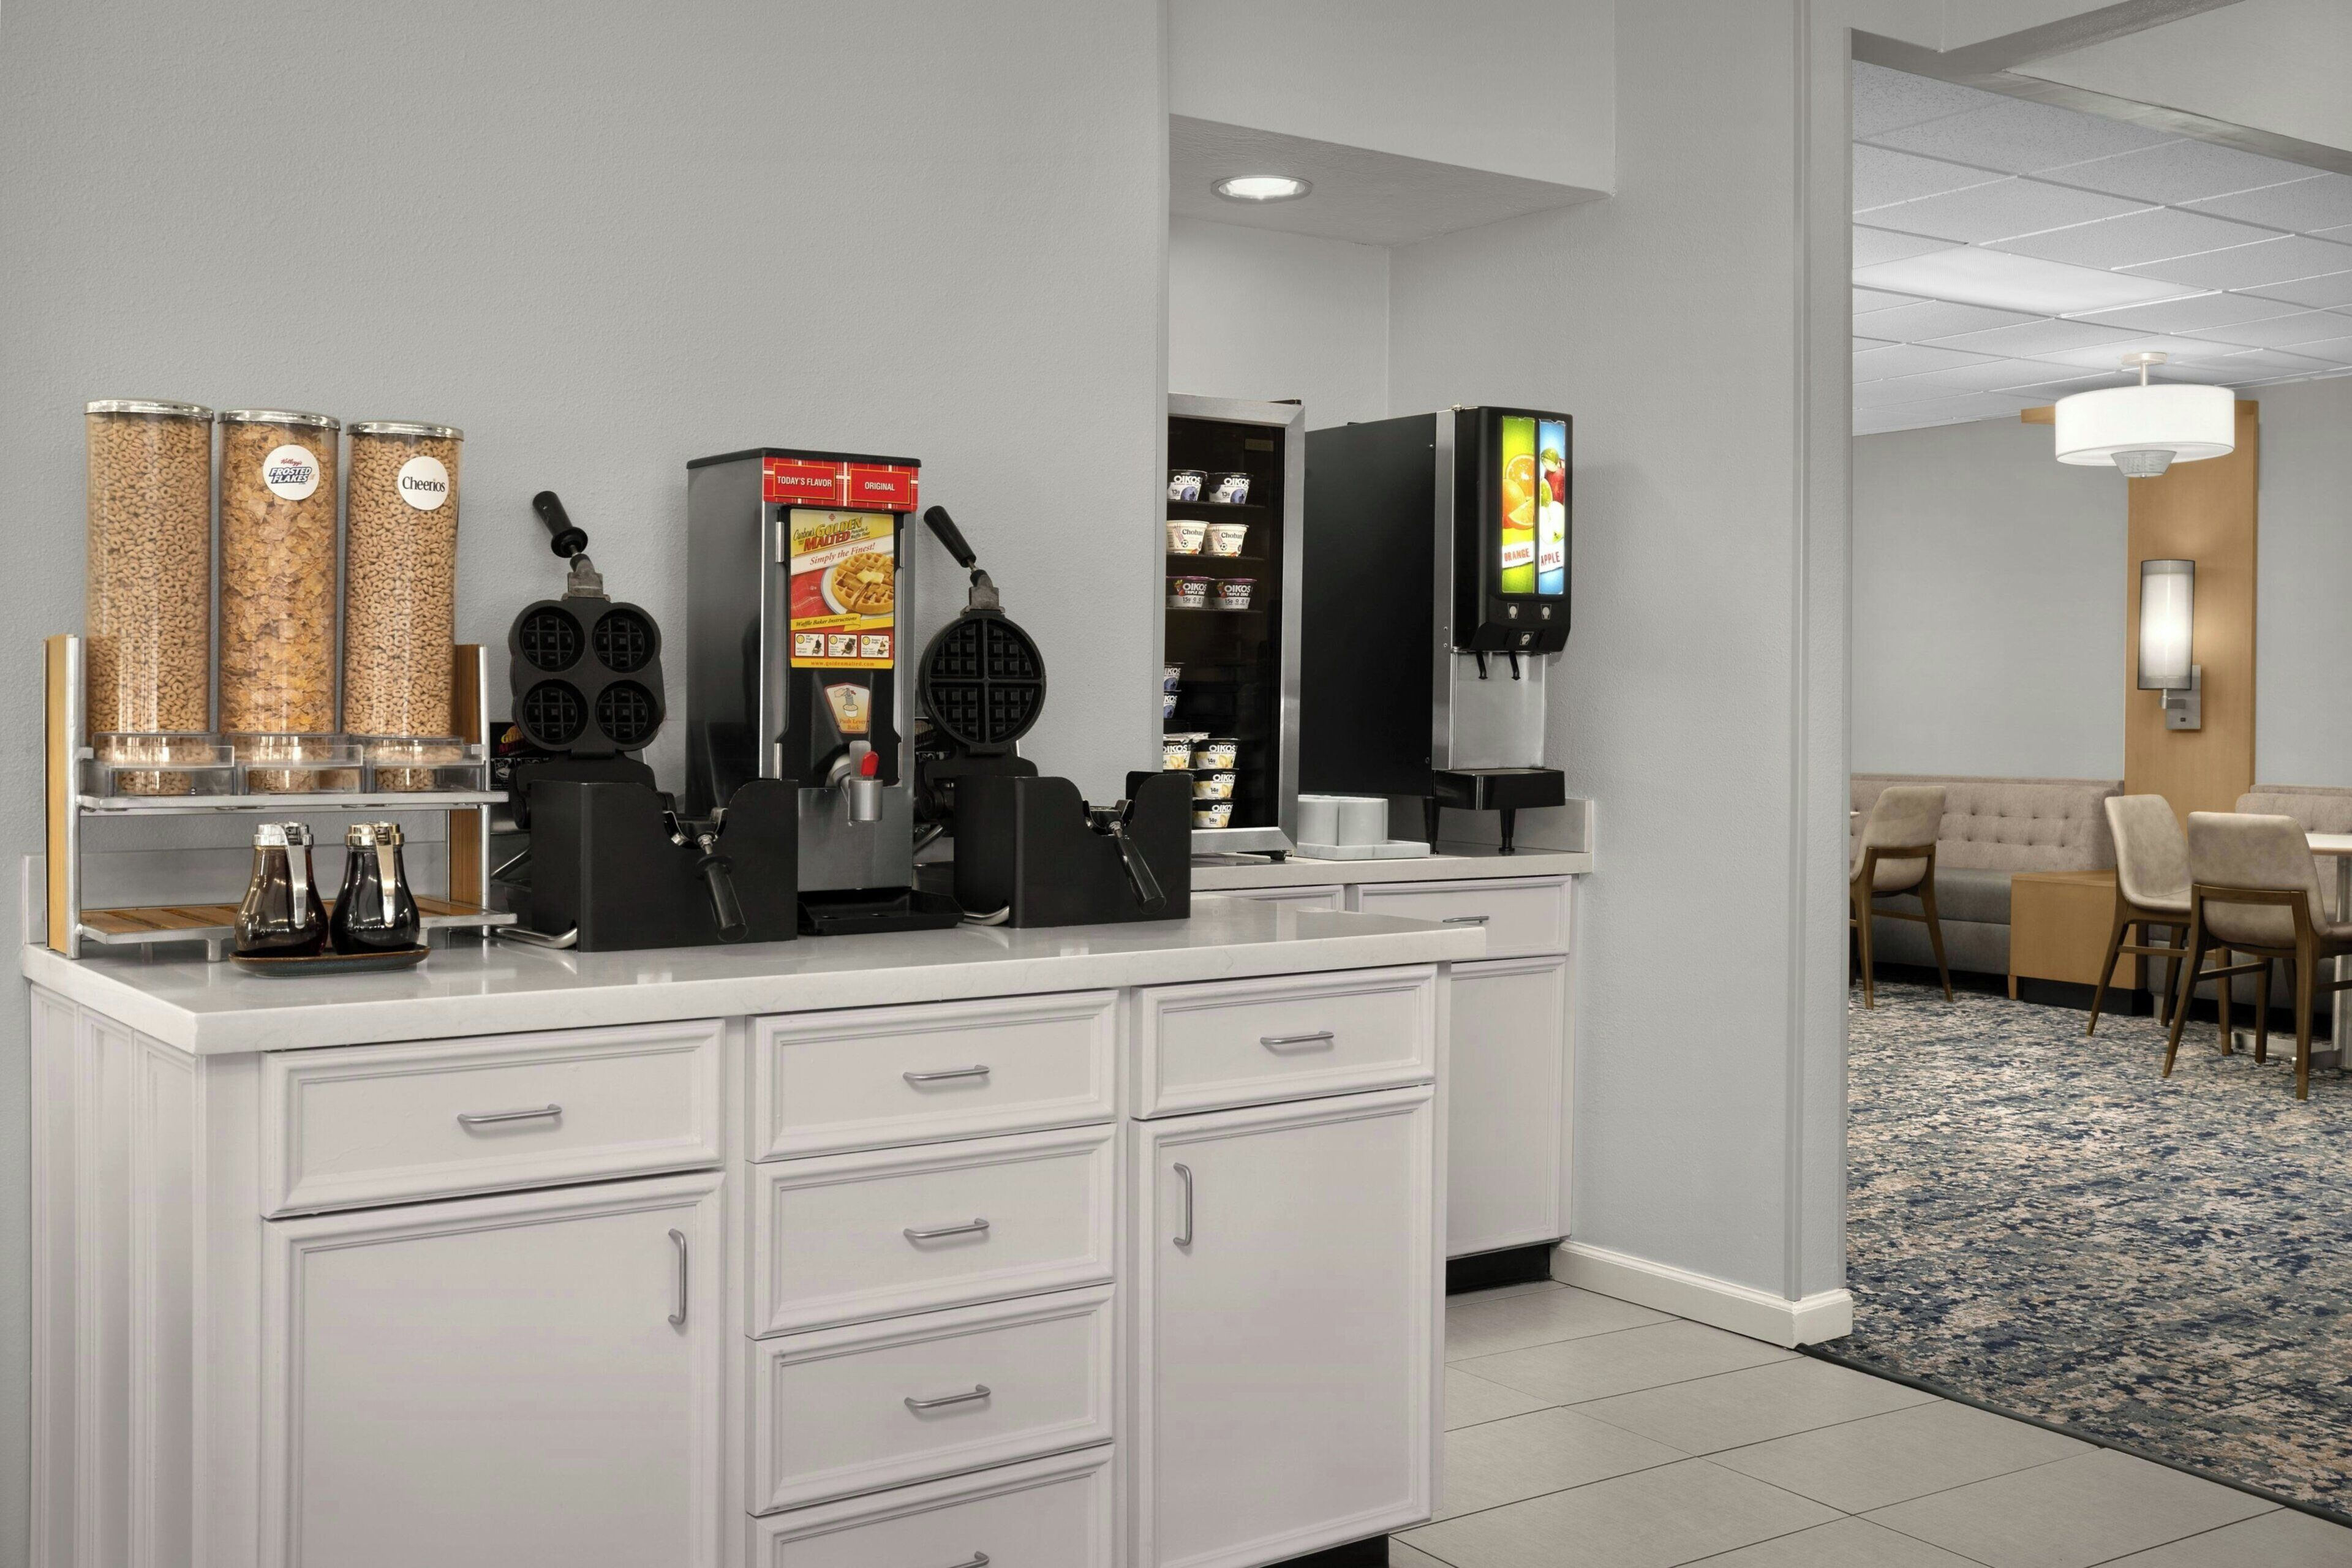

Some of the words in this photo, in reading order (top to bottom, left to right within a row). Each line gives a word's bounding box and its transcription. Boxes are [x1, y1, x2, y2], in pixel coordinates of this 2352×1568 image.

[270, 467, 311, 476] FROSTED
[273, 475, 308, 483] FLAKES
[402, 476, 445, 492] Cheerios
[777, 476, 805, 486] TODAY'S
[807, 478, 832, 487] FLAVOR
[1174, 475, 1201, 484] OIKOS
[1224, 478, 1250, 486] OIKOS
[865, 481, 895, 491] ORIGINAL
[815, 517, 862, 538] GOLDEN
[804, 530, 851, 551] MALTED
[810, 552, 836, 565] Simply
[837, 550, 850, 559] the
[851, 542, 876, 555] Finest!
[1504, 548, 1531, 562] ORANGE
[1540, 551, 1561, 566] APPLE
[1183, 582, 1207, 592] OIKOS
[1224, 584, 1251, 593] OIKOS
[1209, 744, 1236, 753] OIKOS
